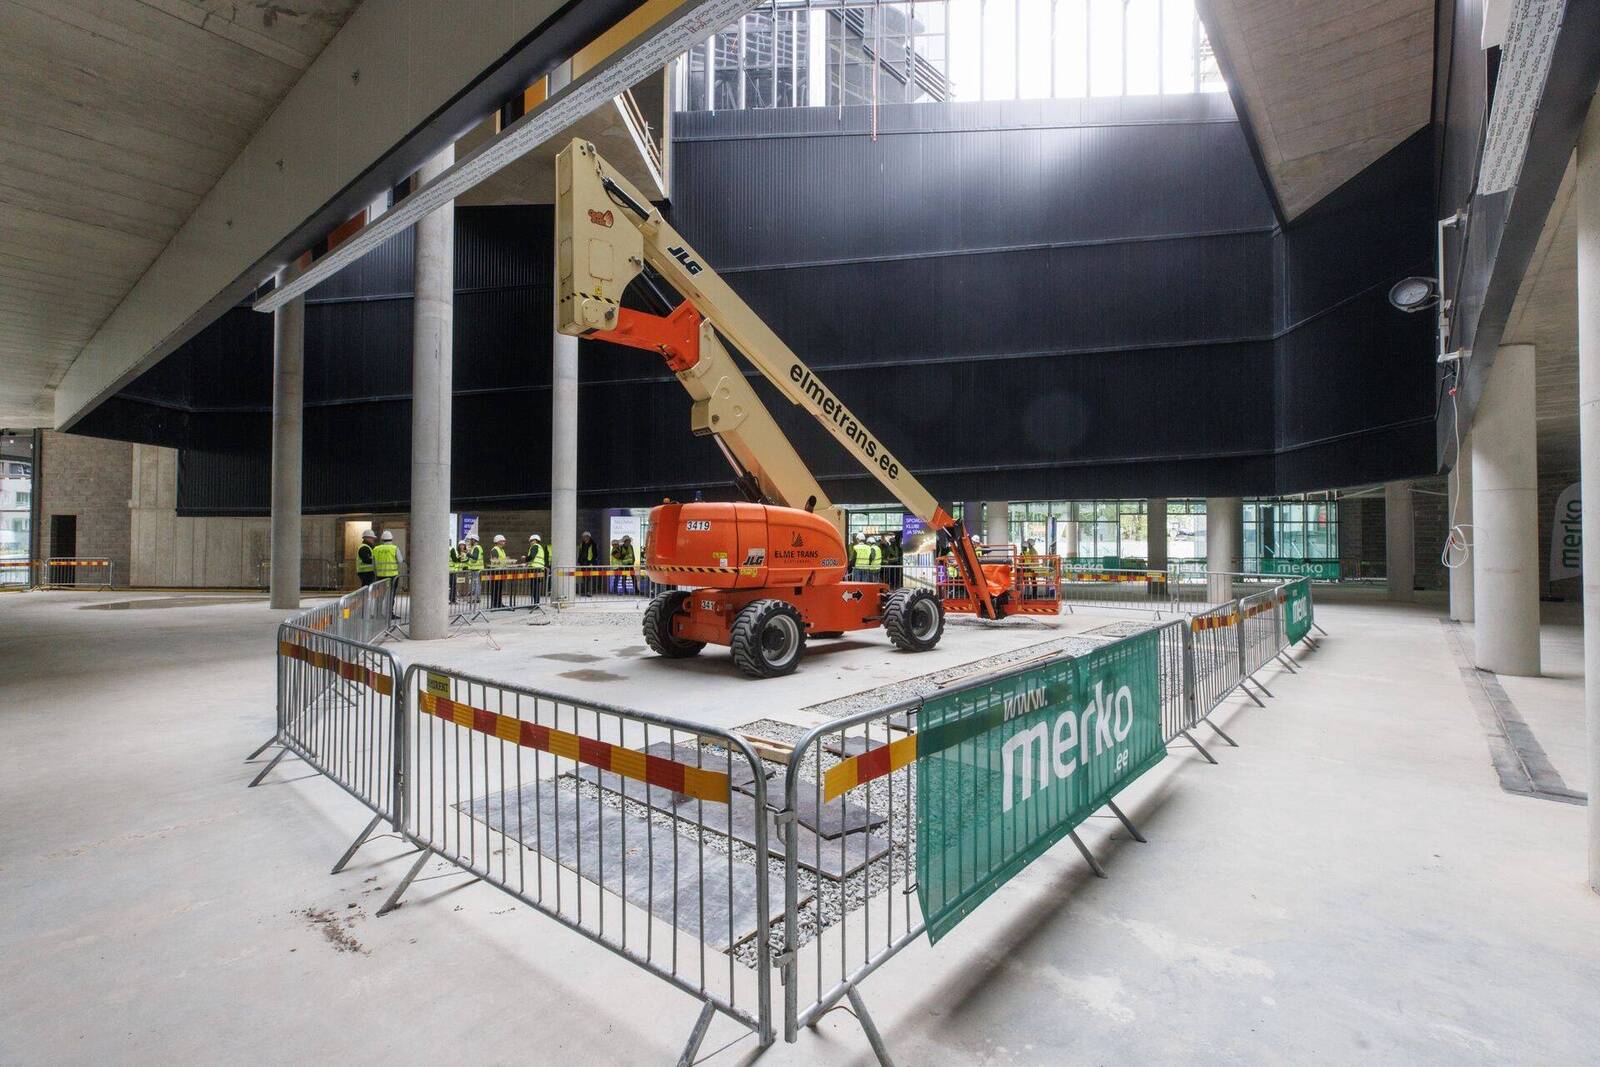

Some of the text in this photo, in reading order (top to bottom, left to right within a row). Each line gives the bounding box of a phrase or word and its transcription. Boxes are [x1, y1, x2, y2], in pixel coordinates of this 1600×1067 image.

[667, 245, 703, 276] JLG
[789, 363, 900, 480] elmetrans.ee
[687, 521, 710, 531] 3419
[1560, 500, 1583, 568] merko
[743, 555, 765, 566] JLG
[774, 550, 819, 558] ELME TRANS
[1277, 562, 1323, 573] merko
[1003, 686, 1048, 722] www.
[1001, 679, 1134, 813] merko
[1113, 748, 1129, 774] .ee
